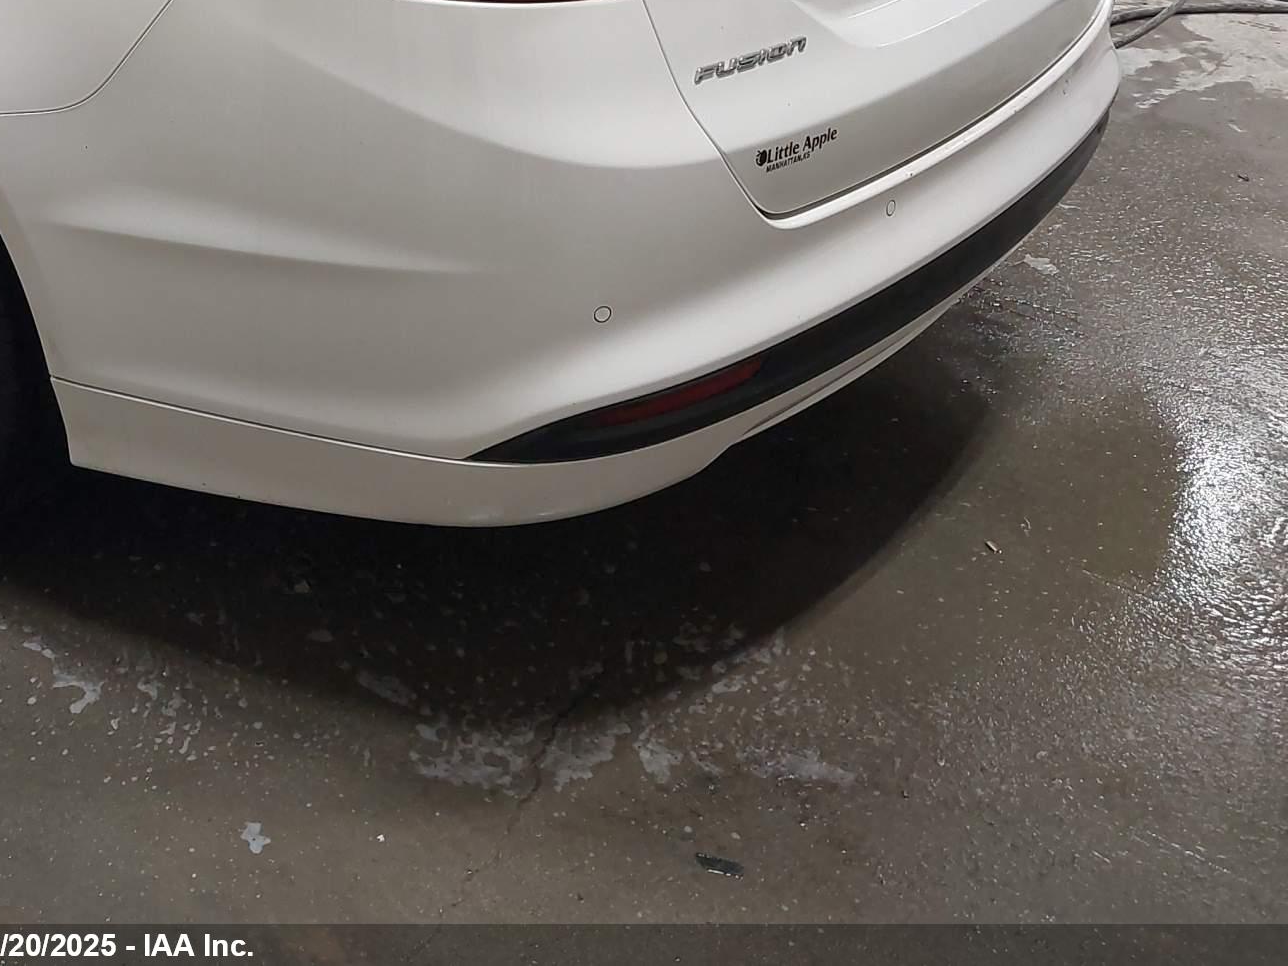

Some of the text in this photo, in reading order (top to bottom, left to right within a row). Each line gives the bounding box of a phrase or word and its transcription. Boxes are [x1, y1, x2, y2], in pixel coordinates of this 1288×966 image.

[694, 35, 807, 85] FUSION
[767, 127, 838, 164] Little Apple
